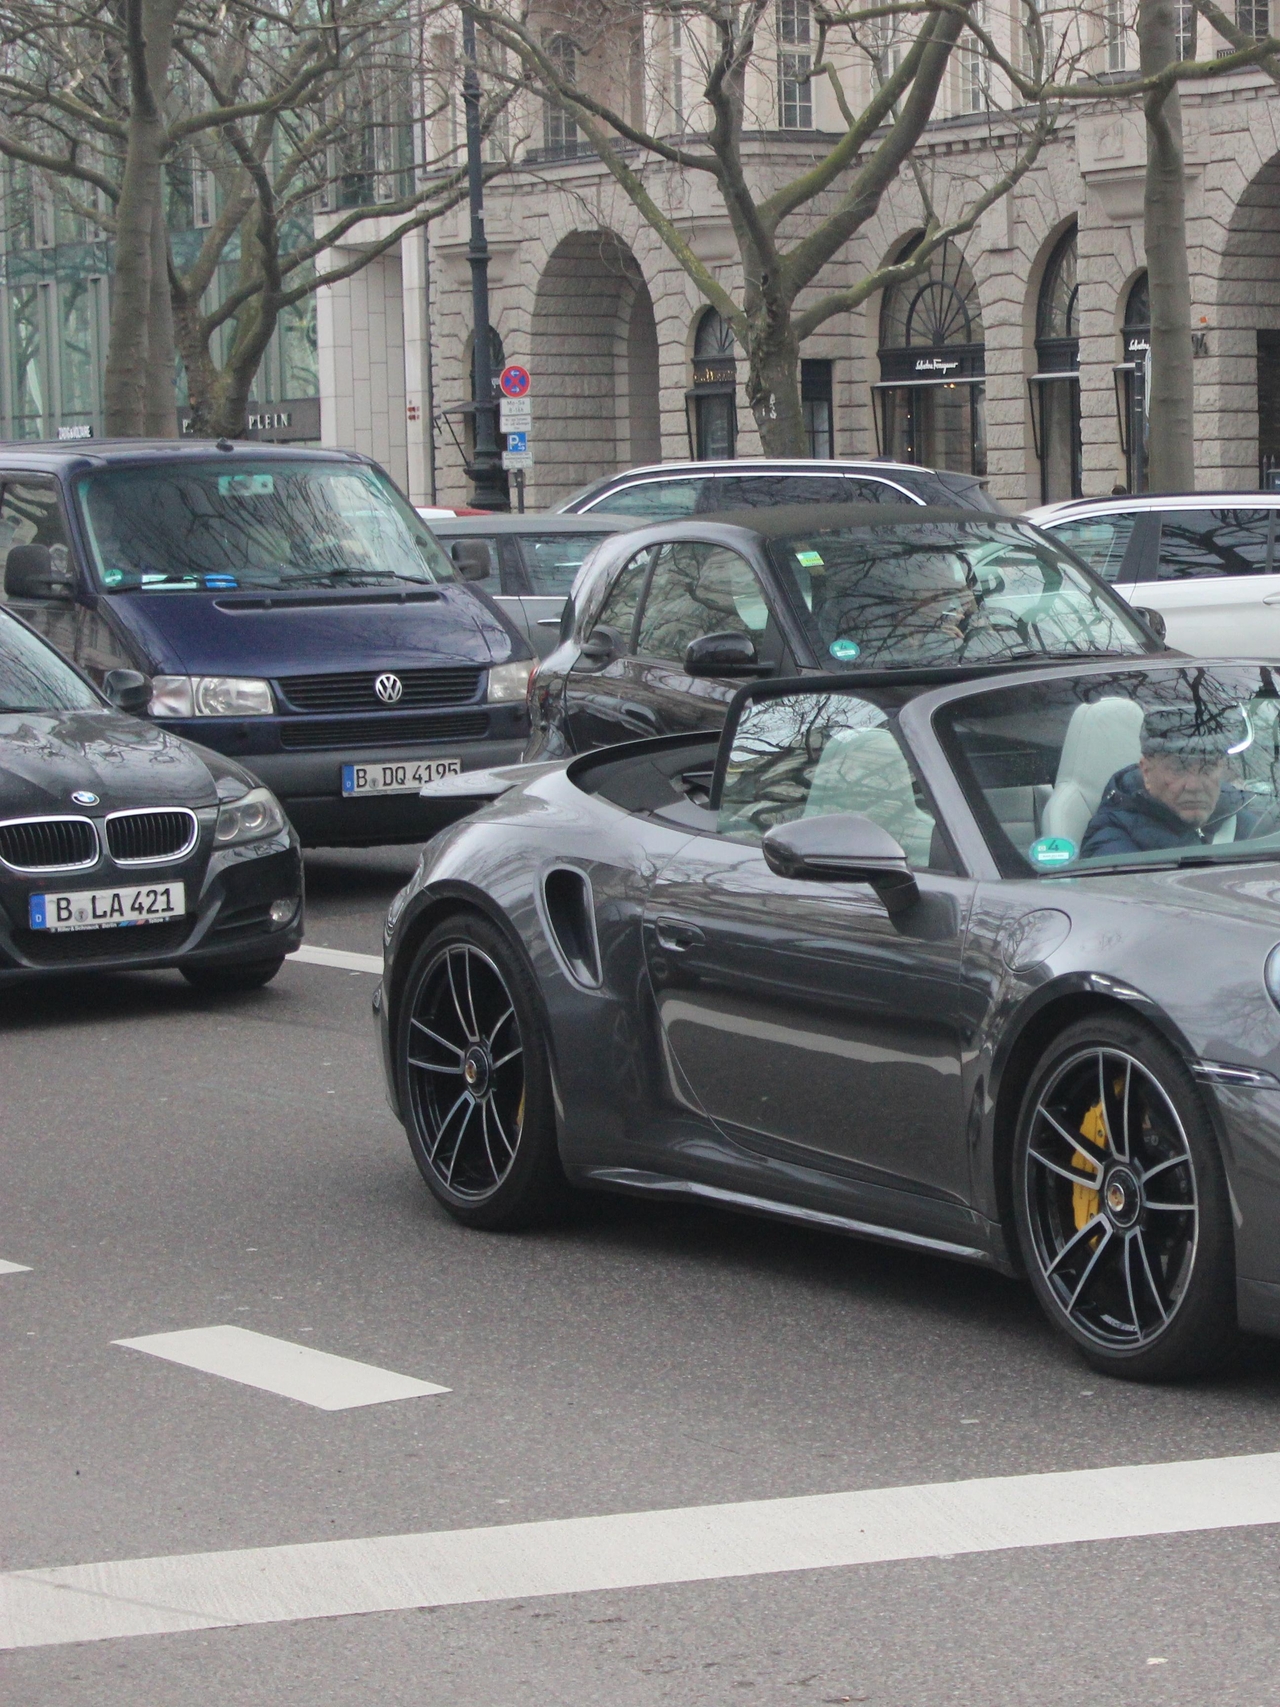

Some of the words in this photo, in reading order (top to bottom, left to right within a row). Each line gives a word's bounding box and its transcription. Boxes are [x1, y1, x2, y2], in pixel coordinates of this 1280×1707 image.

[248, 414, 288, 430] PLEIN
[356, 768, 367, 788] B
[382, 766, 406, 786] DQ
[412, 762, 458, 784] 4195
[1048, 840, 1059, 851] 4
[56, 897, 72, 922] B
[92, 893, 124, 918] LA
[130, 888, 174, 915] 421
